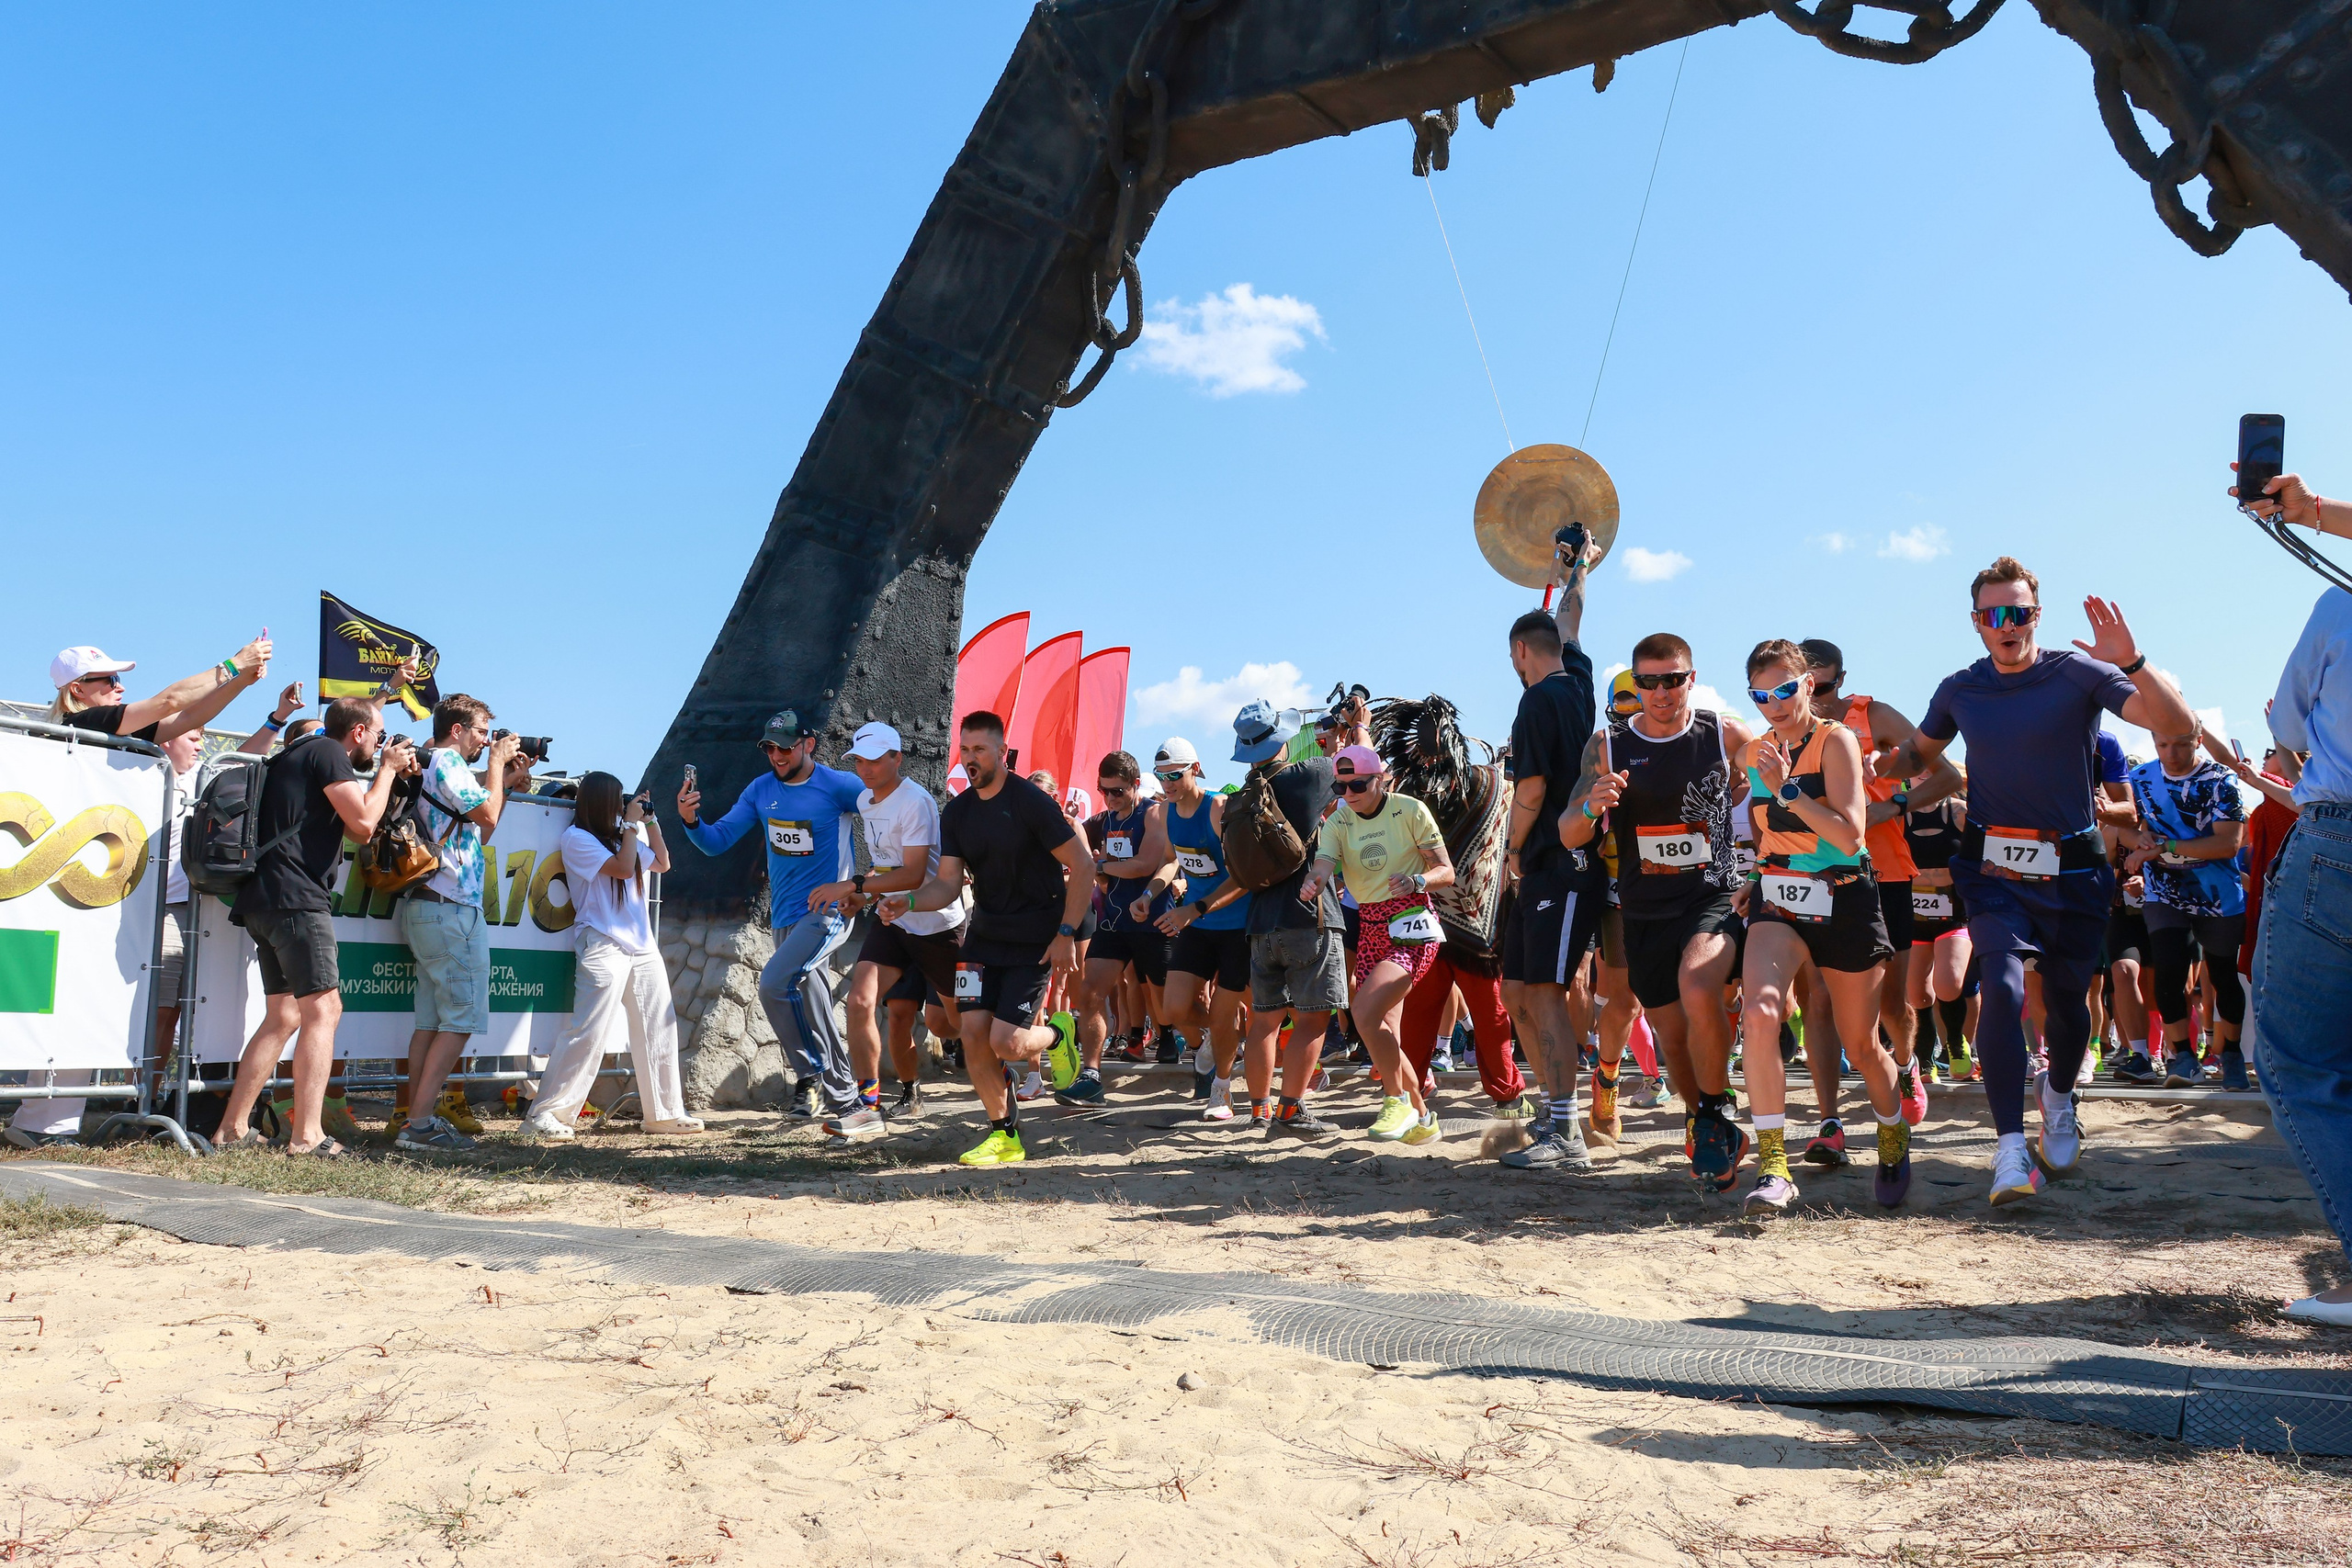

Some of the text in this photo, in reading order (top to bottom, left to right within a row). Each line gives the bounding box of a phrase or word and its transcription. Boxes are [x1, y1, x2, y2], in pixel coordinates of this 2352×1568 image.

[775, 832, 801, 844] 305
[1114, 842, 1123, 852] 97
[1656, 840, 1692, 857] 180
[2004, 846, 2039, 863] 177
[1183, 857, 1204, 868] 278
[1777, 884, 1812, 902] 187
[1913, 897, 1939, 909] 224
[1403, 919, 1430, 933] 741
[372, 961, 518, 983] ФЕСТ РТА,
[339, 978, 405, 995] МУЗЫКИ
[489, 982, 544, 997] АЖЕНИЯ
